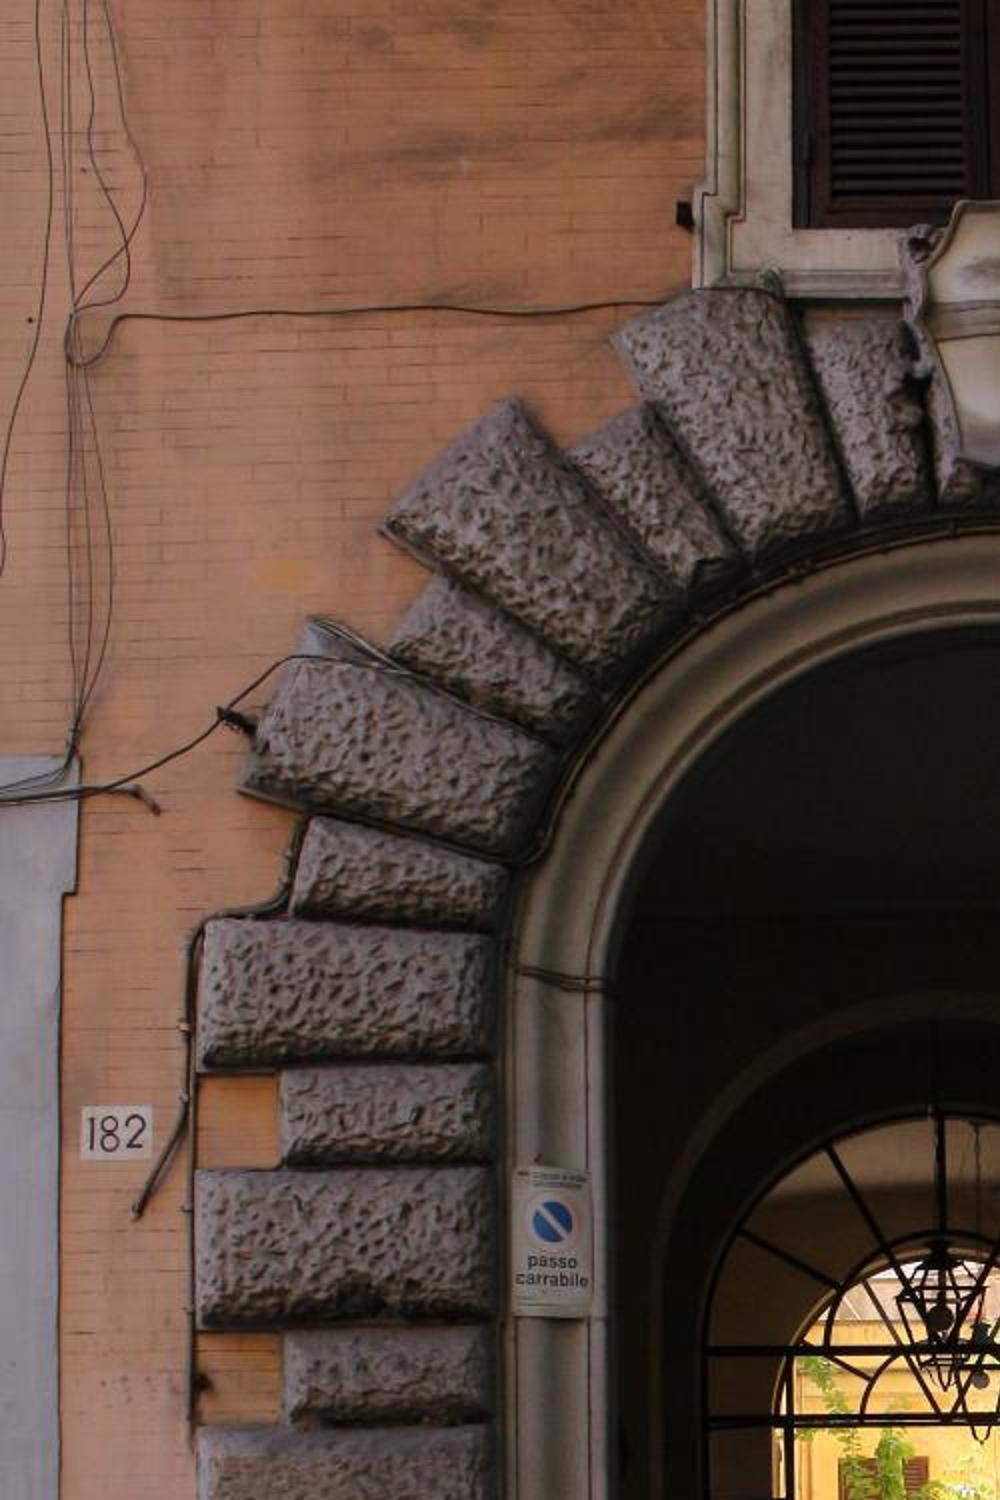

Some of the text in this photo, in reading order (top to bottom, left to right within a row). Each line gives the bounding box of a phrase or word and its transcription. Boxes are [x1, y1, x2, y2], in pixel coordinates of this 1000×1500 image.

[89, 1114, 147, 1153] 182
[527, 1256, 578, 1270] passo
[516, 1272, 588, 1287] carrabile
